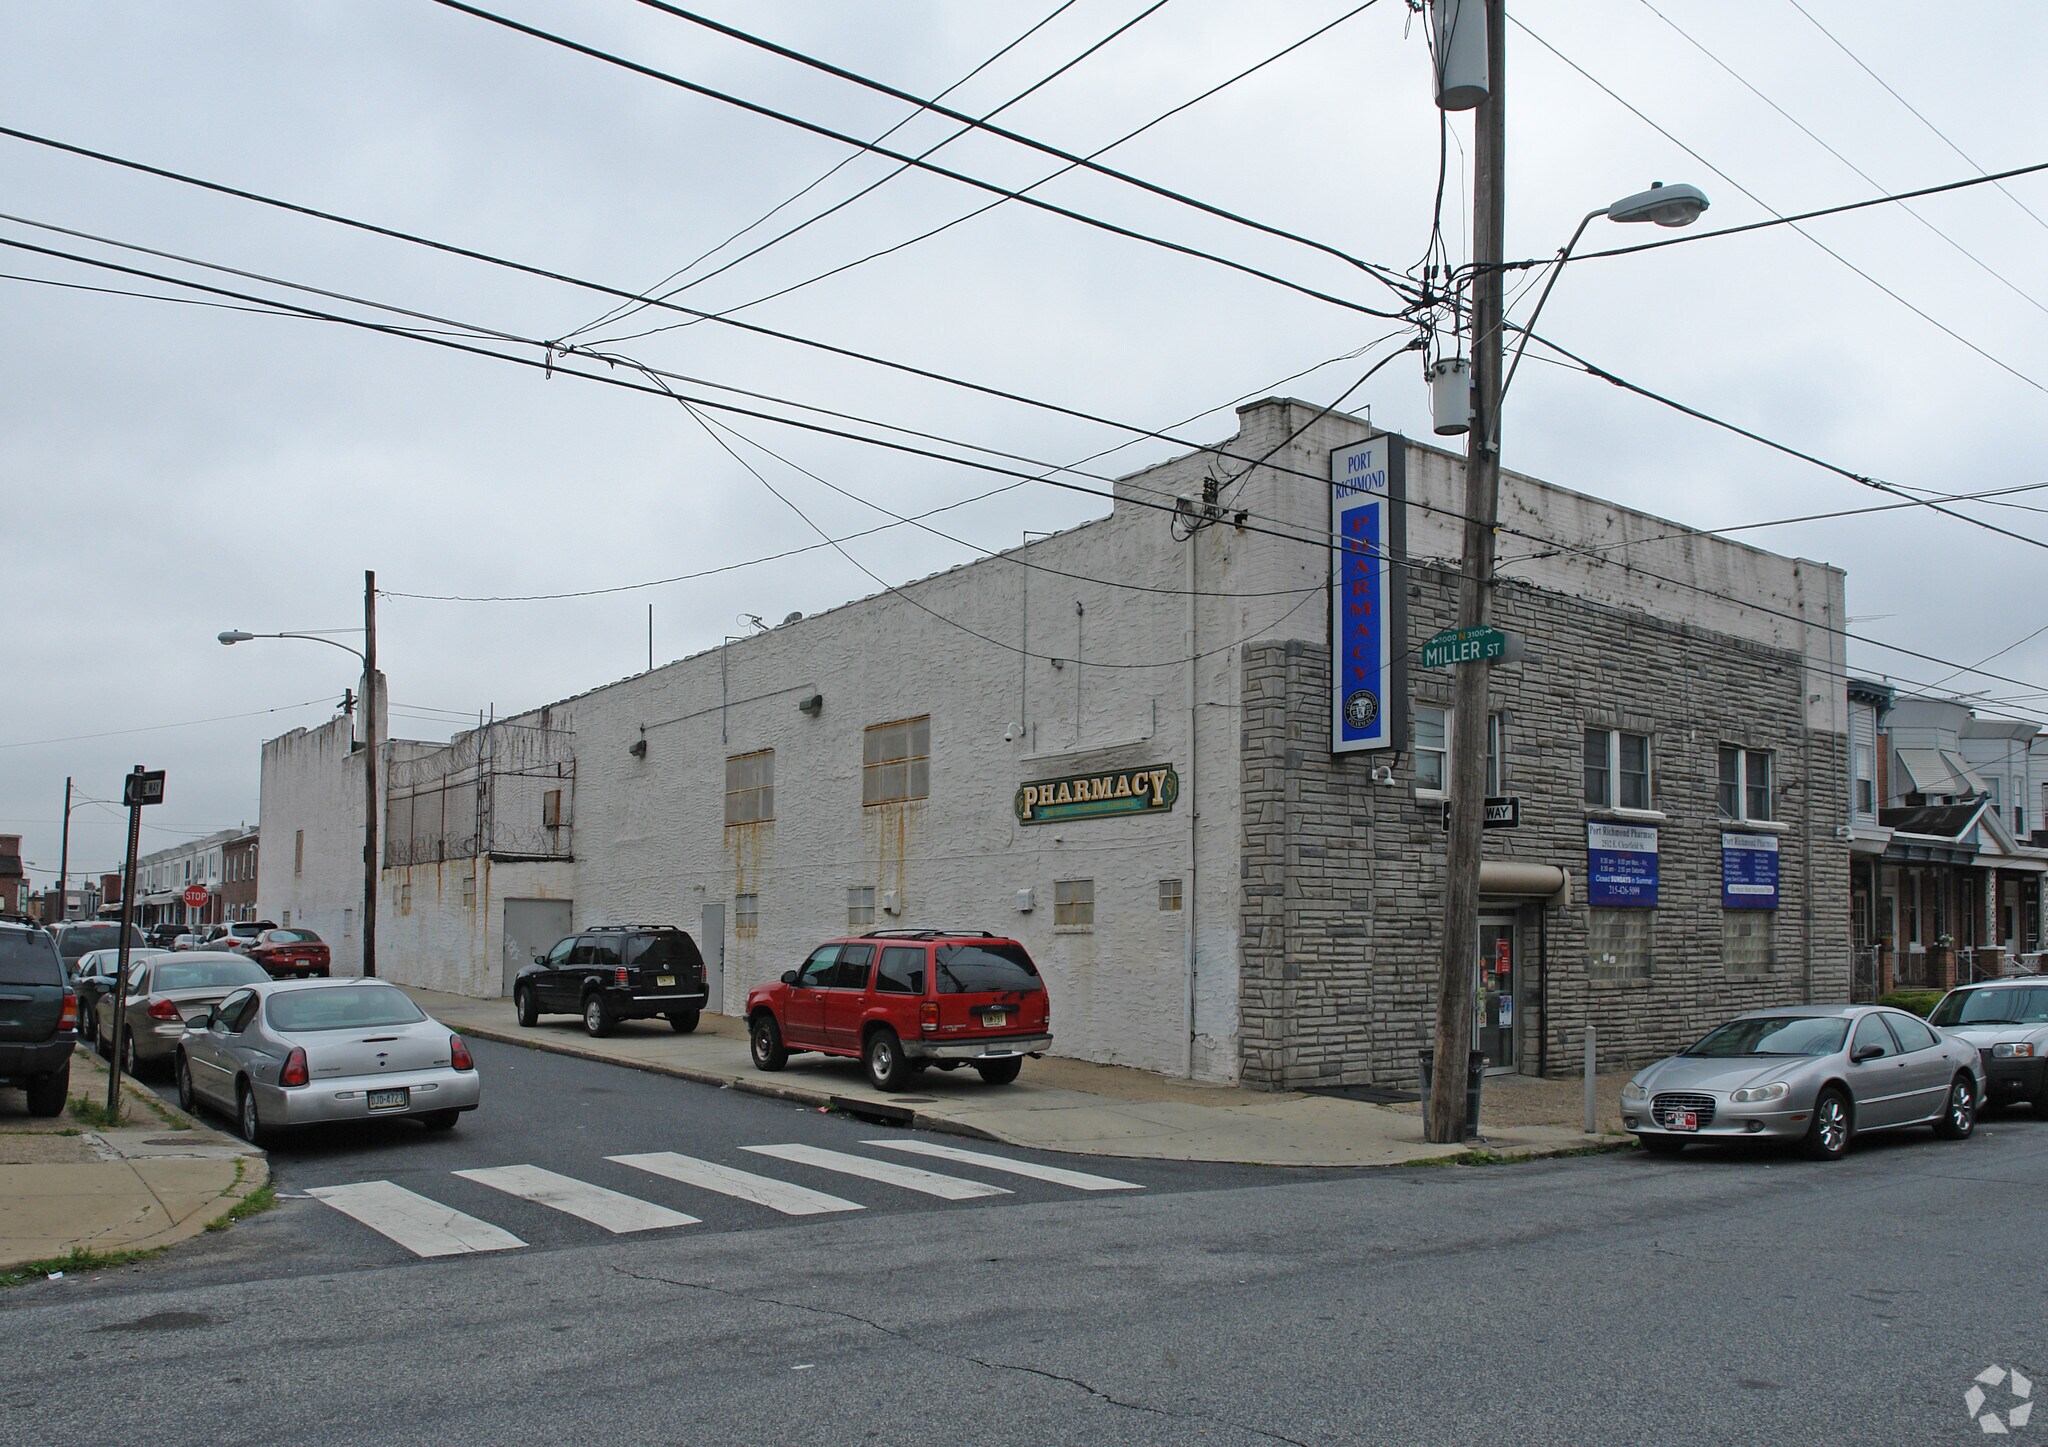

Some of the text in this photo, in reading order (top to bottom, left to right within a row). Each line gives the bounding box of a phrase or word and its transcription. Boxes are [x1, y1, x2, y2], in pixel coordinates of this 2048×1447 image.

[1348, 450, 1372, 474] PORT
[1335, 469, 1385, 499] RICHMOND
[1350, 515, 1371, 681] PHARMACY
[1467, 629, 1485, 639] 3100
[1426, 640, 1500, 666] MILLER ST
[148, 781, 160, 794] WAY
[1022, 769, 1168, 819] PHARMACY
[1486, 806, 1509, 819] WAY
[1589, 825, 1656, 841] Port Richmond Pharmacy
[1595, 874, 1610, 883] Closed
[1610, 875, 1631, 883] SUNDAYS
[1635, 876, 1653, 885] Summer
[185, 891, 207, 901] STOP
